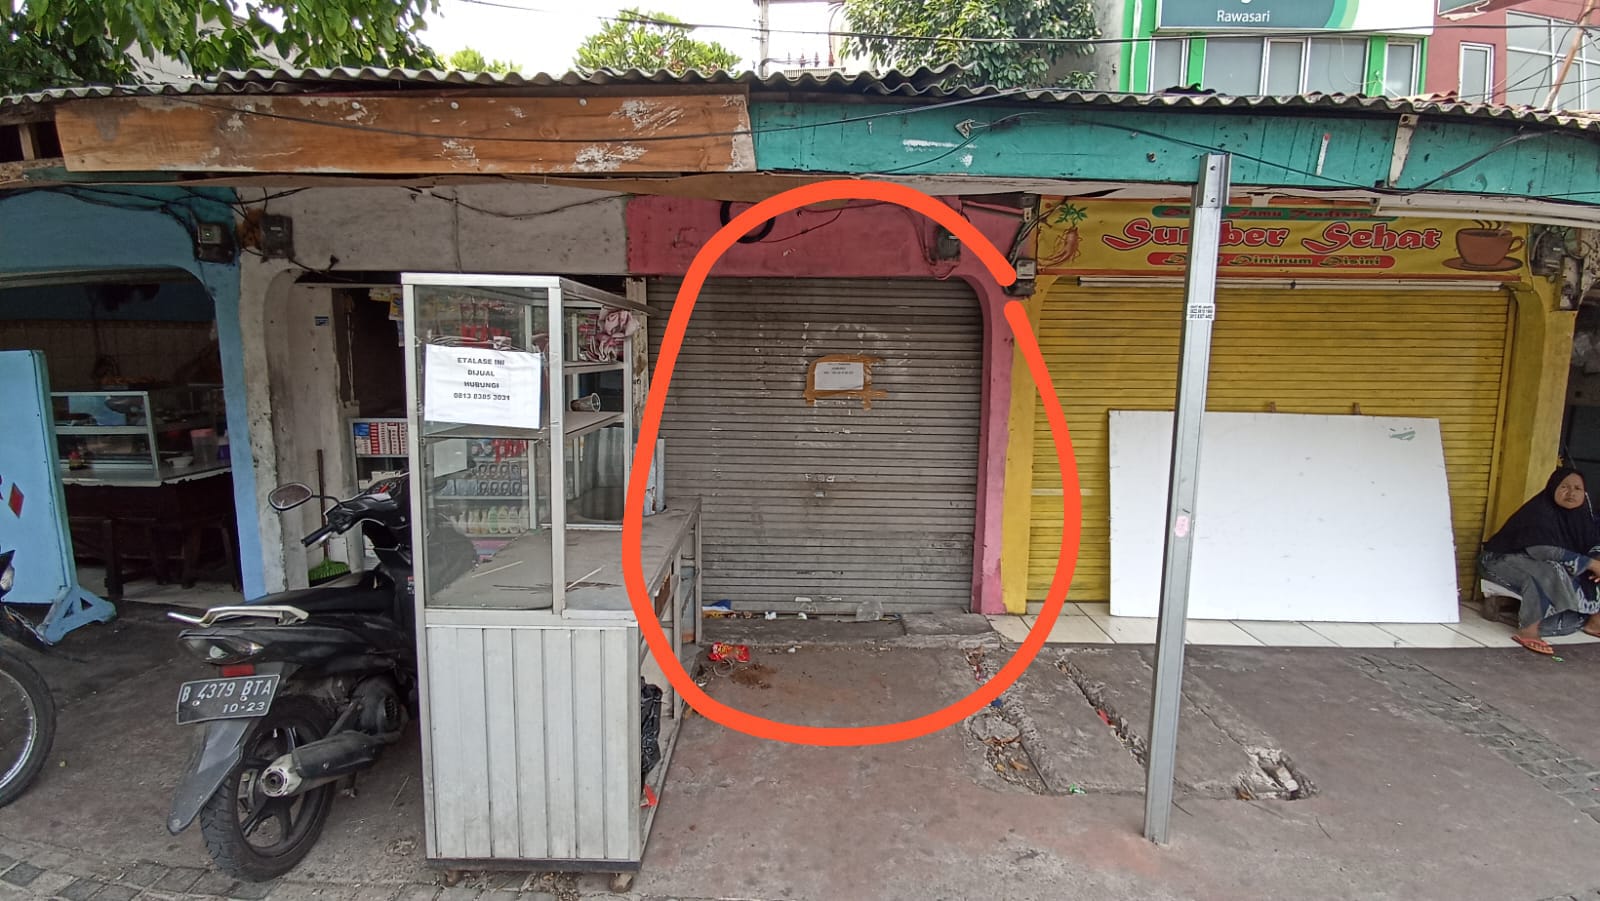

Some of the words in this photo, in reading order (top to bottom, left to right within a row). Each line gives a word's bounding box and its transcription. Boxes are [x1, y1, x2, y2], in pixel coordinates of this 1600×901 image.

[1216, 9, 1271, 23] Rawasari
[1301, 221, 1442, 254] Sehat
[457, 357, 492, 365] ETALASE
[467, 369, 495, 377] DIJUAL
[464, 381, 500, 389] HUBUNGI
[181, 685, 191, 703] B
[197, 682, 236, 700] 4379
[241, 680, 272, 696] BTA
